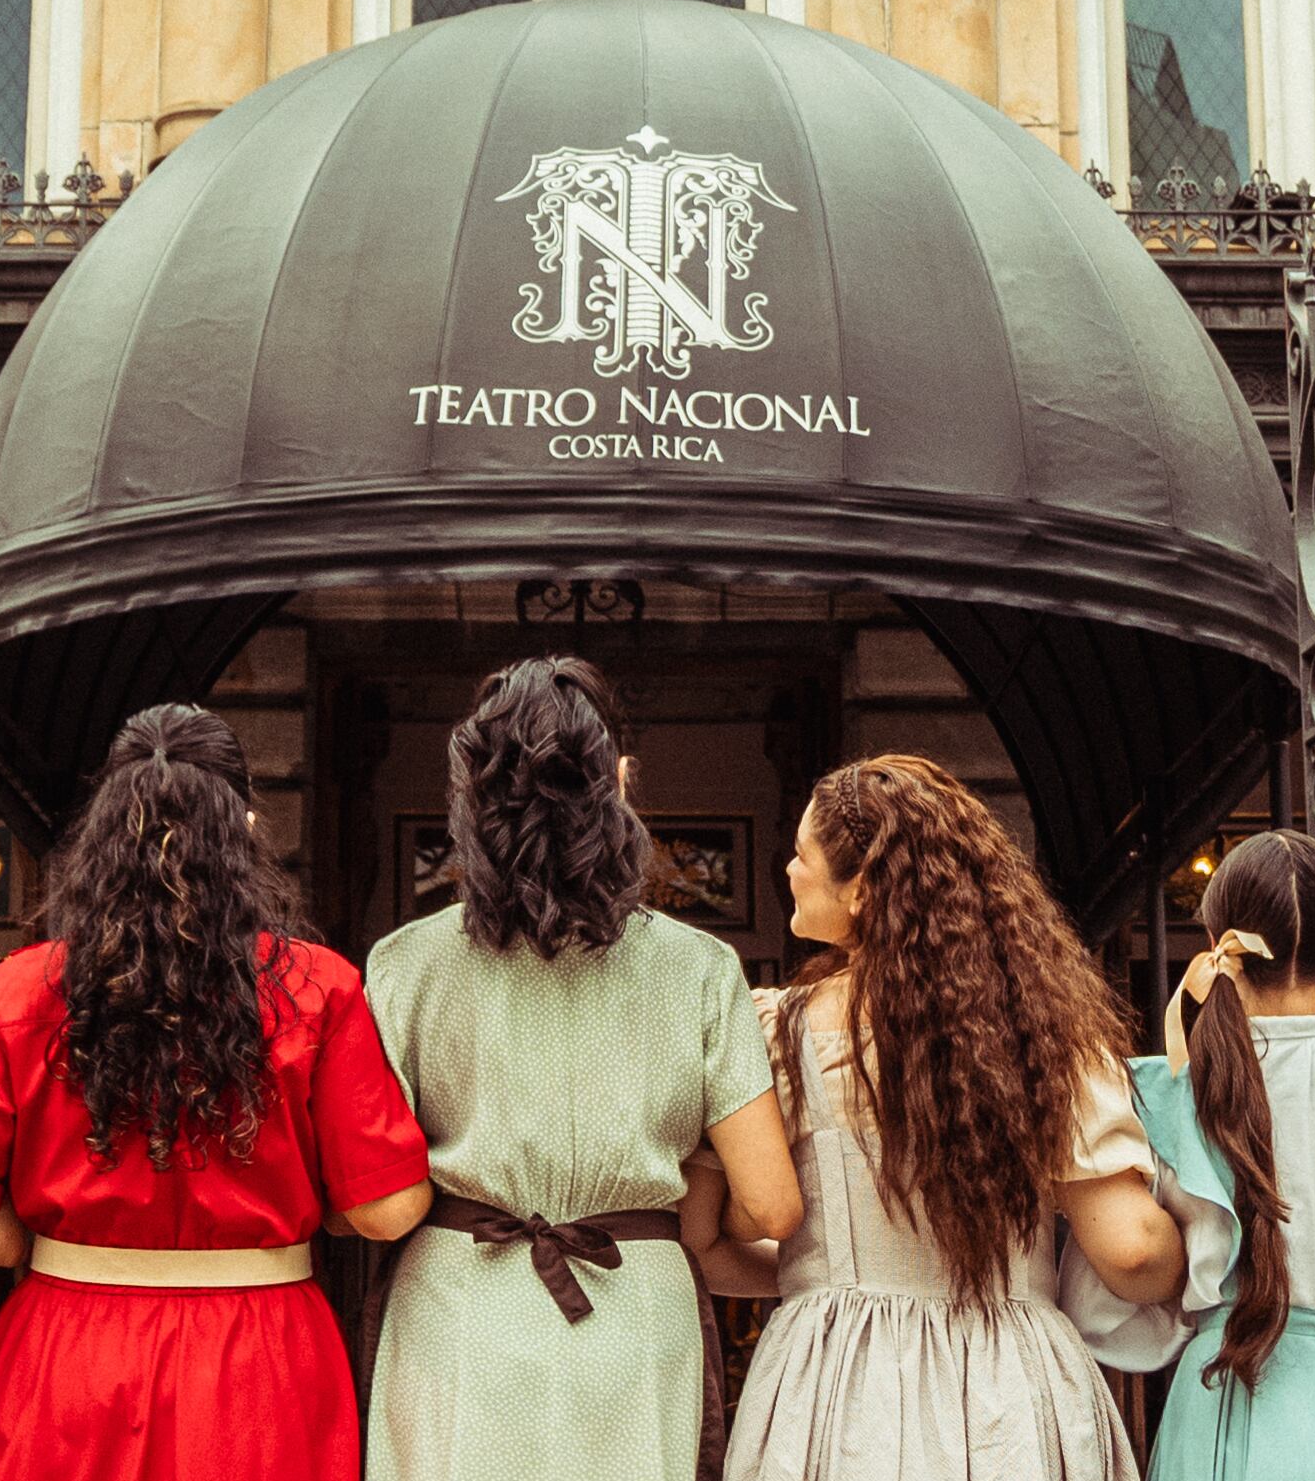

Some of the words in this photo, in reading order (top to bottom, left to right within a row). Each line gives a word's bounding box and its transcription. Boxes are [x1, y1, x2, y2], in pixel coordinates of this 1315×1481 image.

[409, 384, 598, 428] TEATRO
[617, 386, 872, 437] NACIONAL
[548, 433, 643, 460] COSTA
[652, 436, 724, 463] RICA
